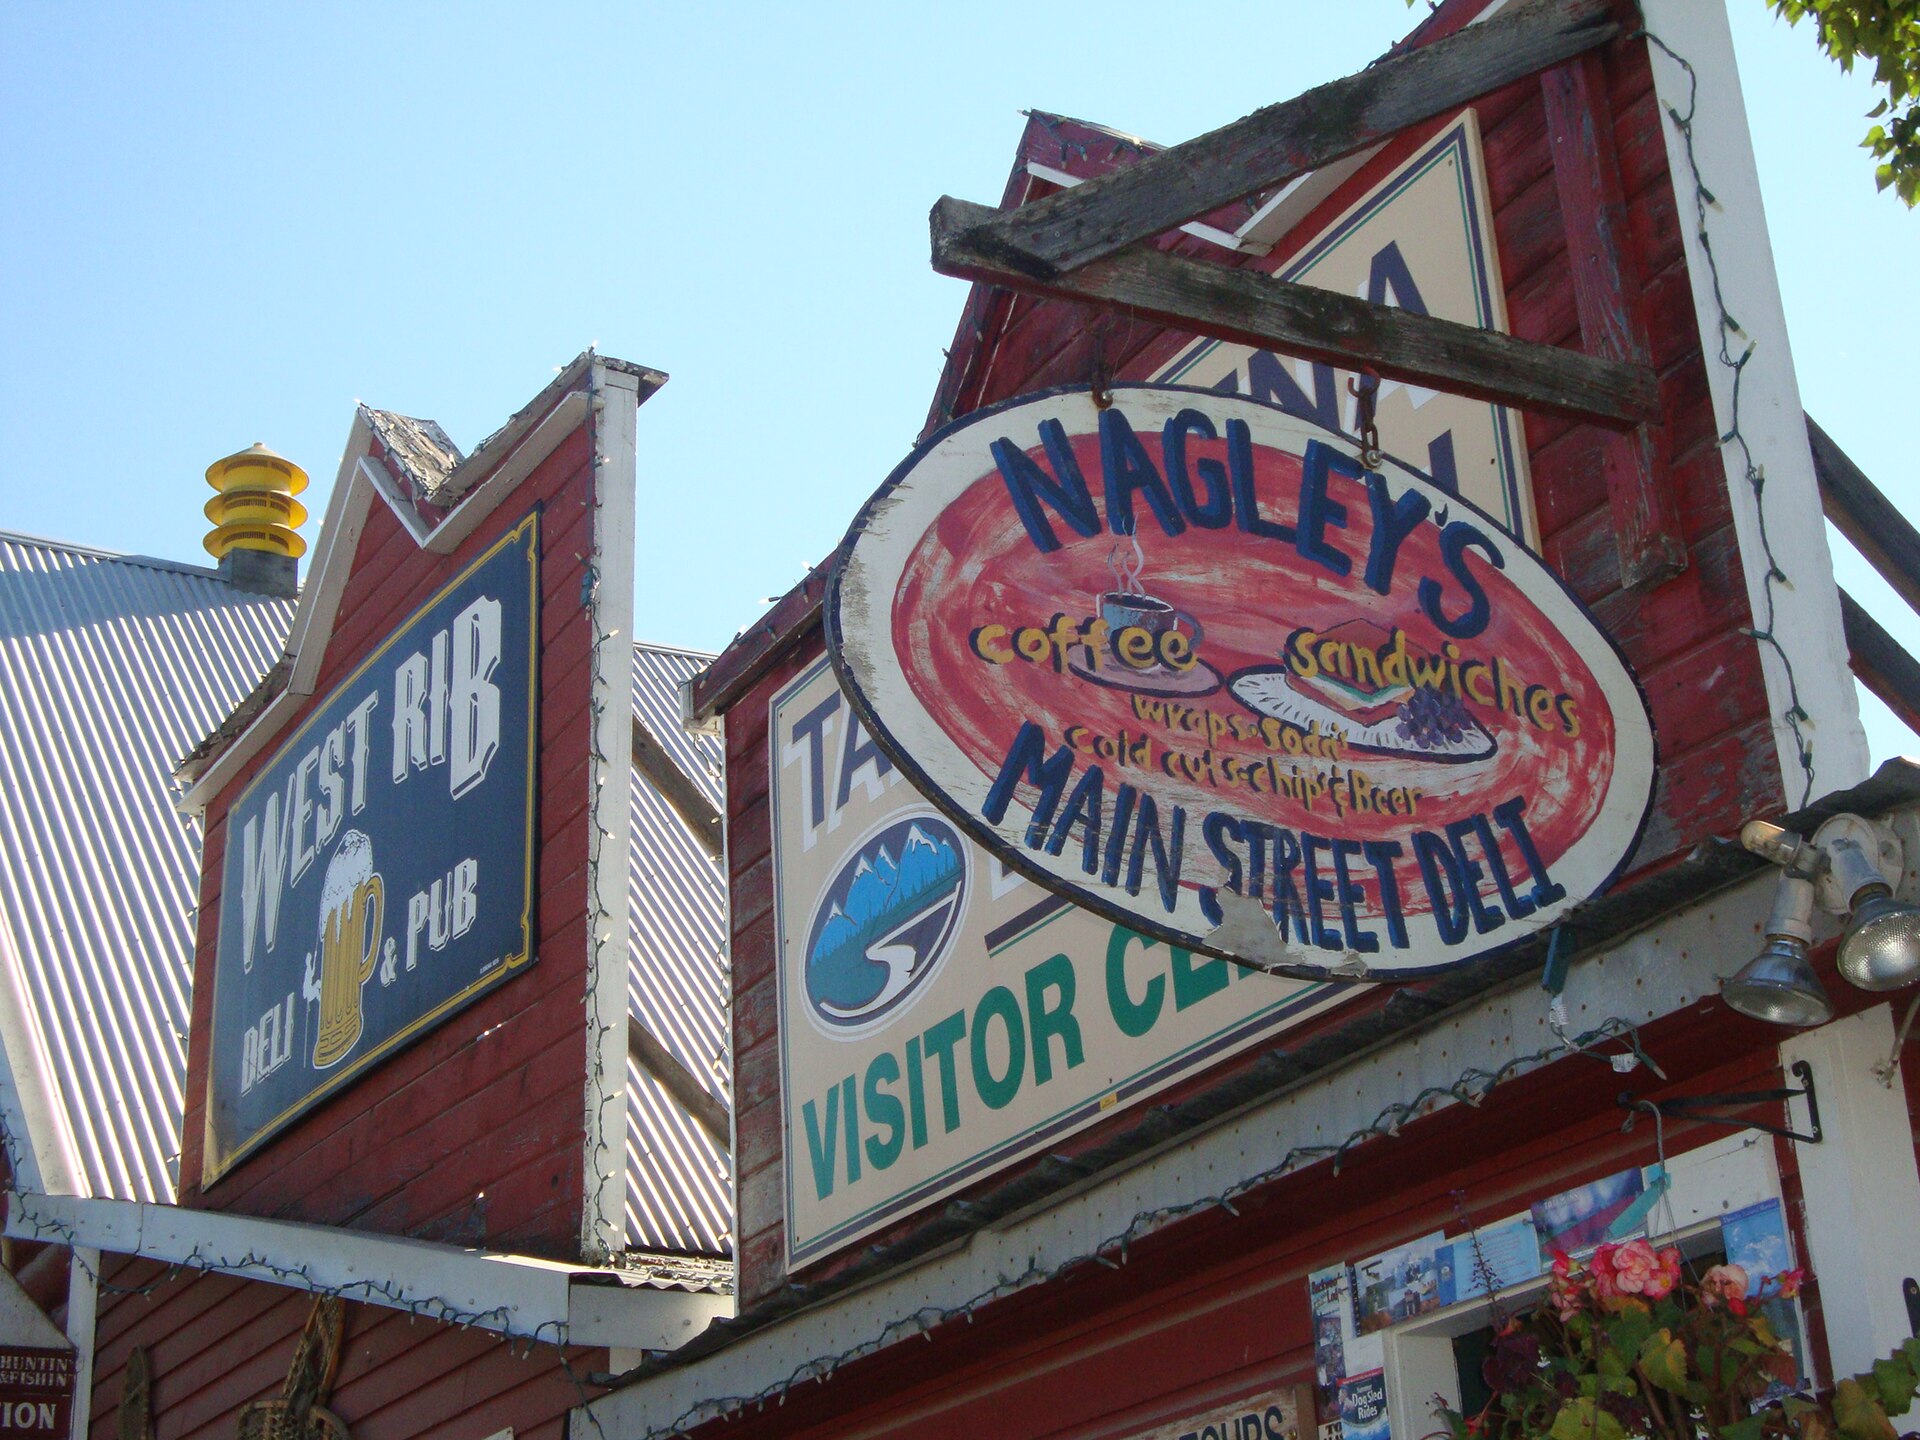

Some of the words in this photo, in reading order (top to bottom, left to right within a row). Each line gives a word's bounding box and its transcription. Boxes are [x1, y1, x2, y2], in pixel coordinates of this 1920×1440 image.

[989, 408, 1504, 638] NAGLEY'S
[969, 612, 1198, 673] coffee
[241, 690, 379, 974] WEST
[391, 594, 502, 801] RIB
[981, 720, 1187, 914] MAIN
[1199, 811, 1411, 954] STREET
[1411, 795, 1567, 946] DELI
[1064, 725, 1152, 770] cold
[1348, 768, 1424, 817] Beer
[241, 990, 297, 1096] DELI
[380, 936, 398, 989] &
[405, 856, 479, 972] PUB
[803, 952, 1085, 1202] VISITOR
[1351, 1393, 1368, 1408] Dog
[1367, 1387, 1383, 1403] Sled
[1357, 1404, 1378, 1420] Rides
